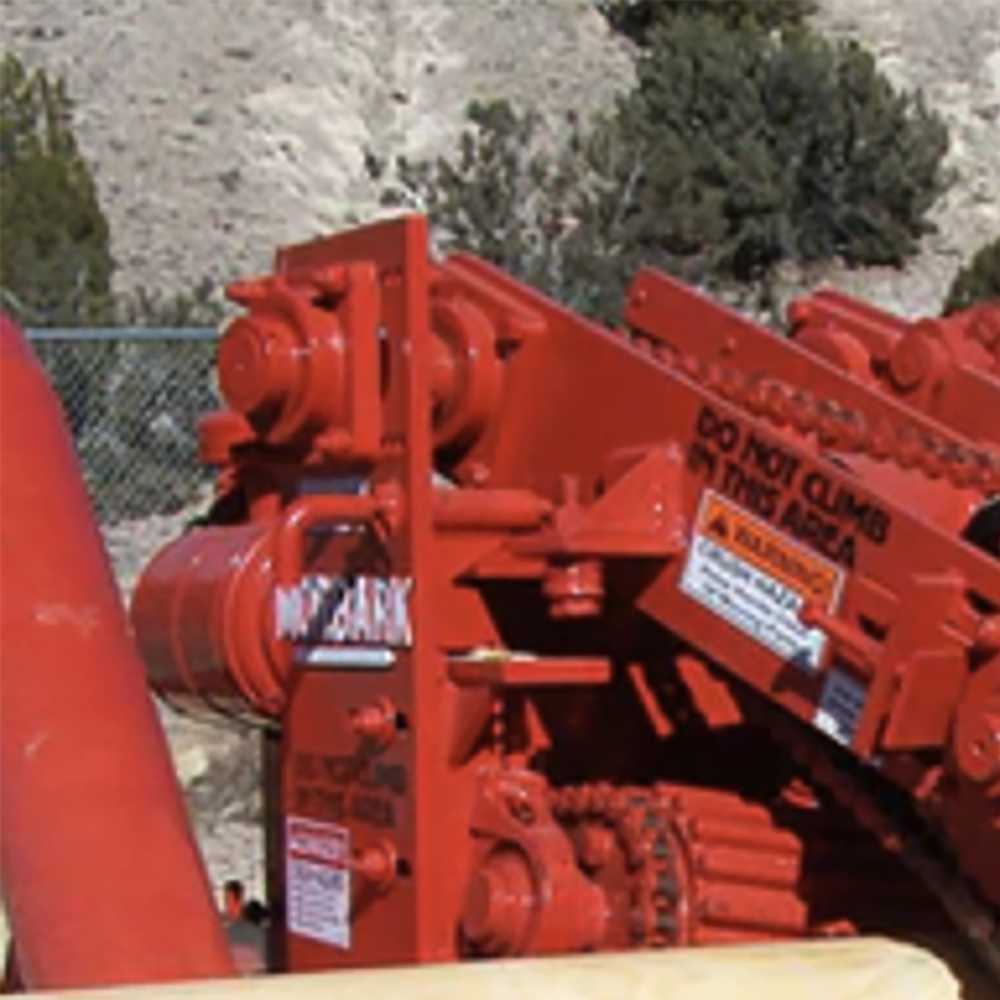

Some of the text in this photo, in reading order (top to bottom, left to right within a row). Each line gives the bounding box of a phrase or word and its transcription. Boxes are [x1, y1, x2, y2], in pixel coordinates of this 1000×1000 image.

[698, 404, 891, 546] DO NOT CLIMB
[723, 460, 779, 518] THIS
[781, 500, 855, 569] AREA
[274, 575, 414, 646] MOBARK
